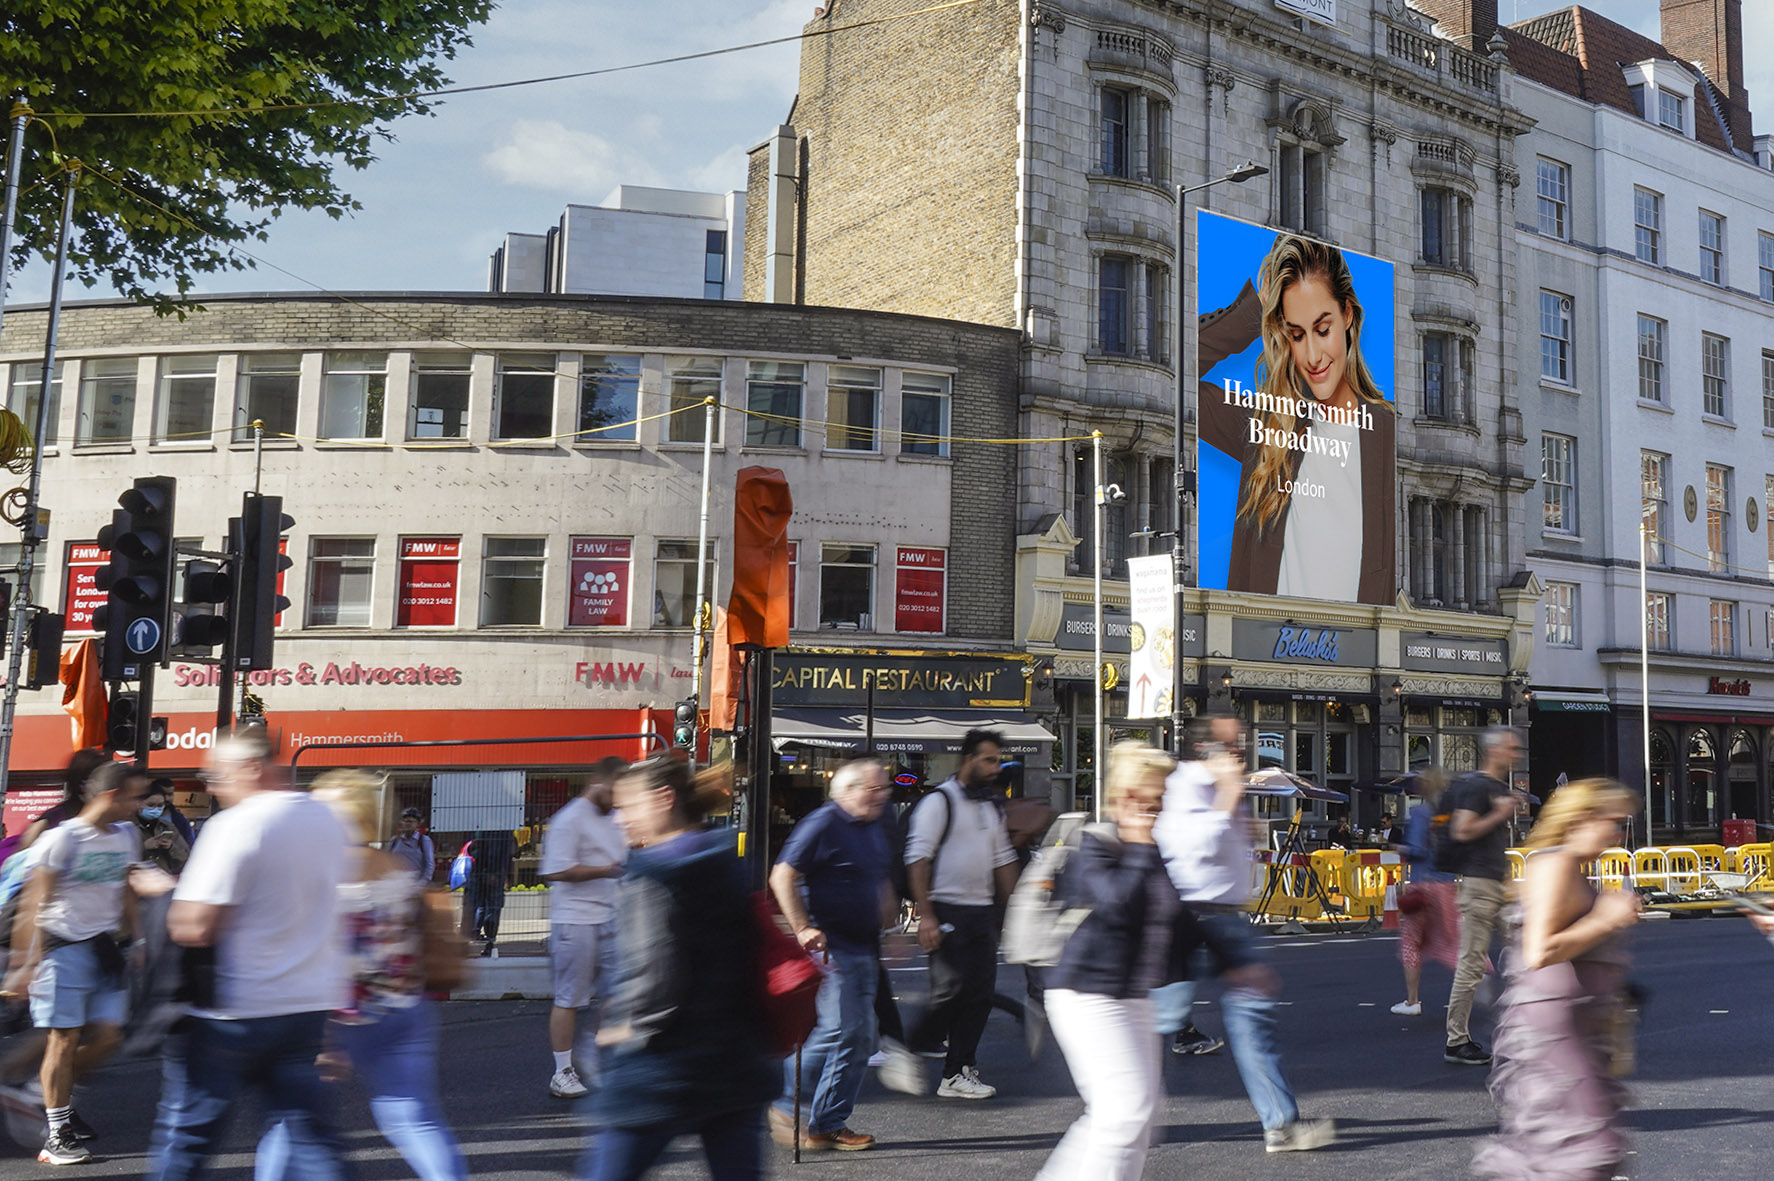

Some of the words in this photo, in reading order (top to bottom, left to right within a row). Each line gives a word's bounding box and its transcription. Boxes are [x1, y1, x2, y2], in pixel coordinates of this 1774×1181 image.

[1223, 378, 1374, 431] Hammersmith
[1249, 417, 1351, 467] Broadway
[1277, 475, 1325, 498] London
[72, 548, 100, 559] FMW
[405, 543, 436, 553] FMW
[576, 544, 607, 553] FMW
[900, 552, 925, 562] FMW
[74, 599, 88, 609] for
[72, 611, 84, 622] 30
[1274, 627, 1340, 662] Belushi's
[1406, 646, 1431, 658] BURGERS
[1436, 648, 1456, 660] DRINKS
[1461, 650, 1480, 661] SPORTS
[1486, 652, 1501, 663] MUSIC
[295, 662, 314, 685] &
[320, 661, 458, 685] Advocates
[575, 662, 645, 683] FMW
[290, 732, 403, 747] Hammersmith
